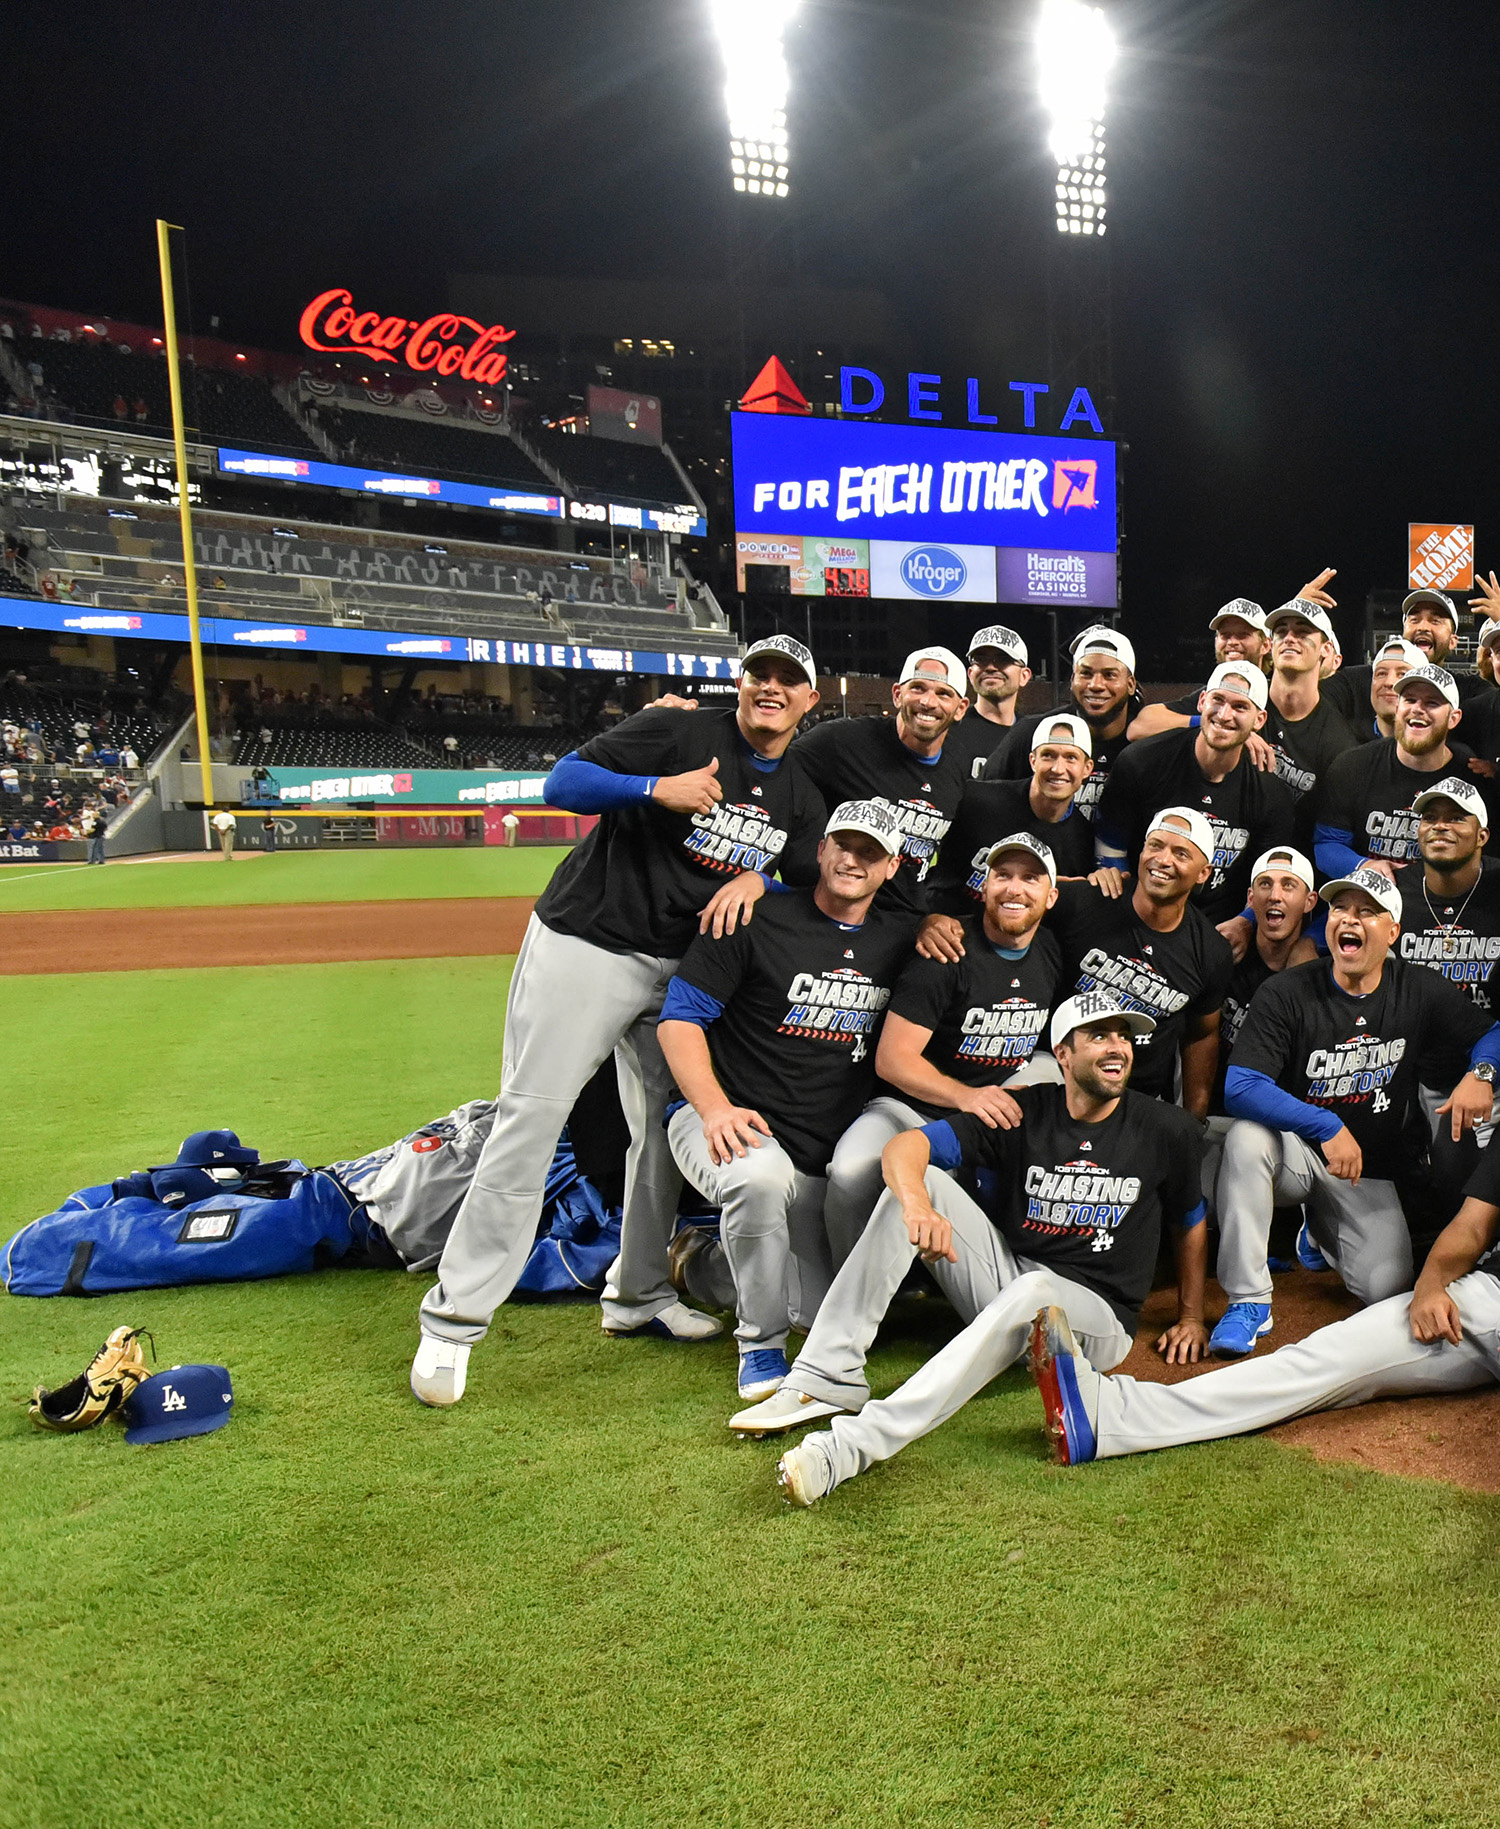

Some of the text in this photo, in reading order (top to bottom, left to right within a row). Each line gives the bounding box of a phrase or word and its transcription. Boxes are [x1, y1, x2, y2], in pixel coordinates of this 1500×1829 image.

[300, 288, 516, 386] Coca-Cola
[840, 366, 1104, 433] DELTA
[753, 459, 1048, 521] FOR EACH OTHER
[829, 546, 856, 557] MEGA
[1410, 525, 1473, 588] HOME
[1416, 531, 1442, 557] THE
[908, 553, 962, 591] Kroger
[1027, 553, 1086, 572] Harrah's
[1434, 549, 1472, 589] DEPOT
[1028, 571, 1086, 583] CHEROKEE
[1028, 582, 1086, 593] CASINOS
[1365, 811, 1420, 839] CHAS
[12, 845, 39, 857] Bat
[243, 836, 317, 845] ININITI
[1369, 837, 1421, 859] H18TO
[822, 971, 872, 984] POSTSEASON
[1079, 948, 1190, 1013] CHASING
[1117, 953, 1168, 983] POSTSEASON
[787, 972, 891, 1010] CHASING
[782, 1005, 879, 1034] H18TORY
[993, 1002, 1036, 1010] POSTSEASON
[851, 1034, 867, 1063] LA
[1306, 1038, 1406, 1079] CHASING
[1371, 1088, 1391, 1114] LA
[1054, 1165, 1110, 1175] POSTSEASON
[1025, 1165, 1142, 1204] CHASING
[1026, 1197, 1131, 1229] H18TORY
[1091, 1229, 1114, 1252] LA
[162, 1385, 187, 1412] LA
